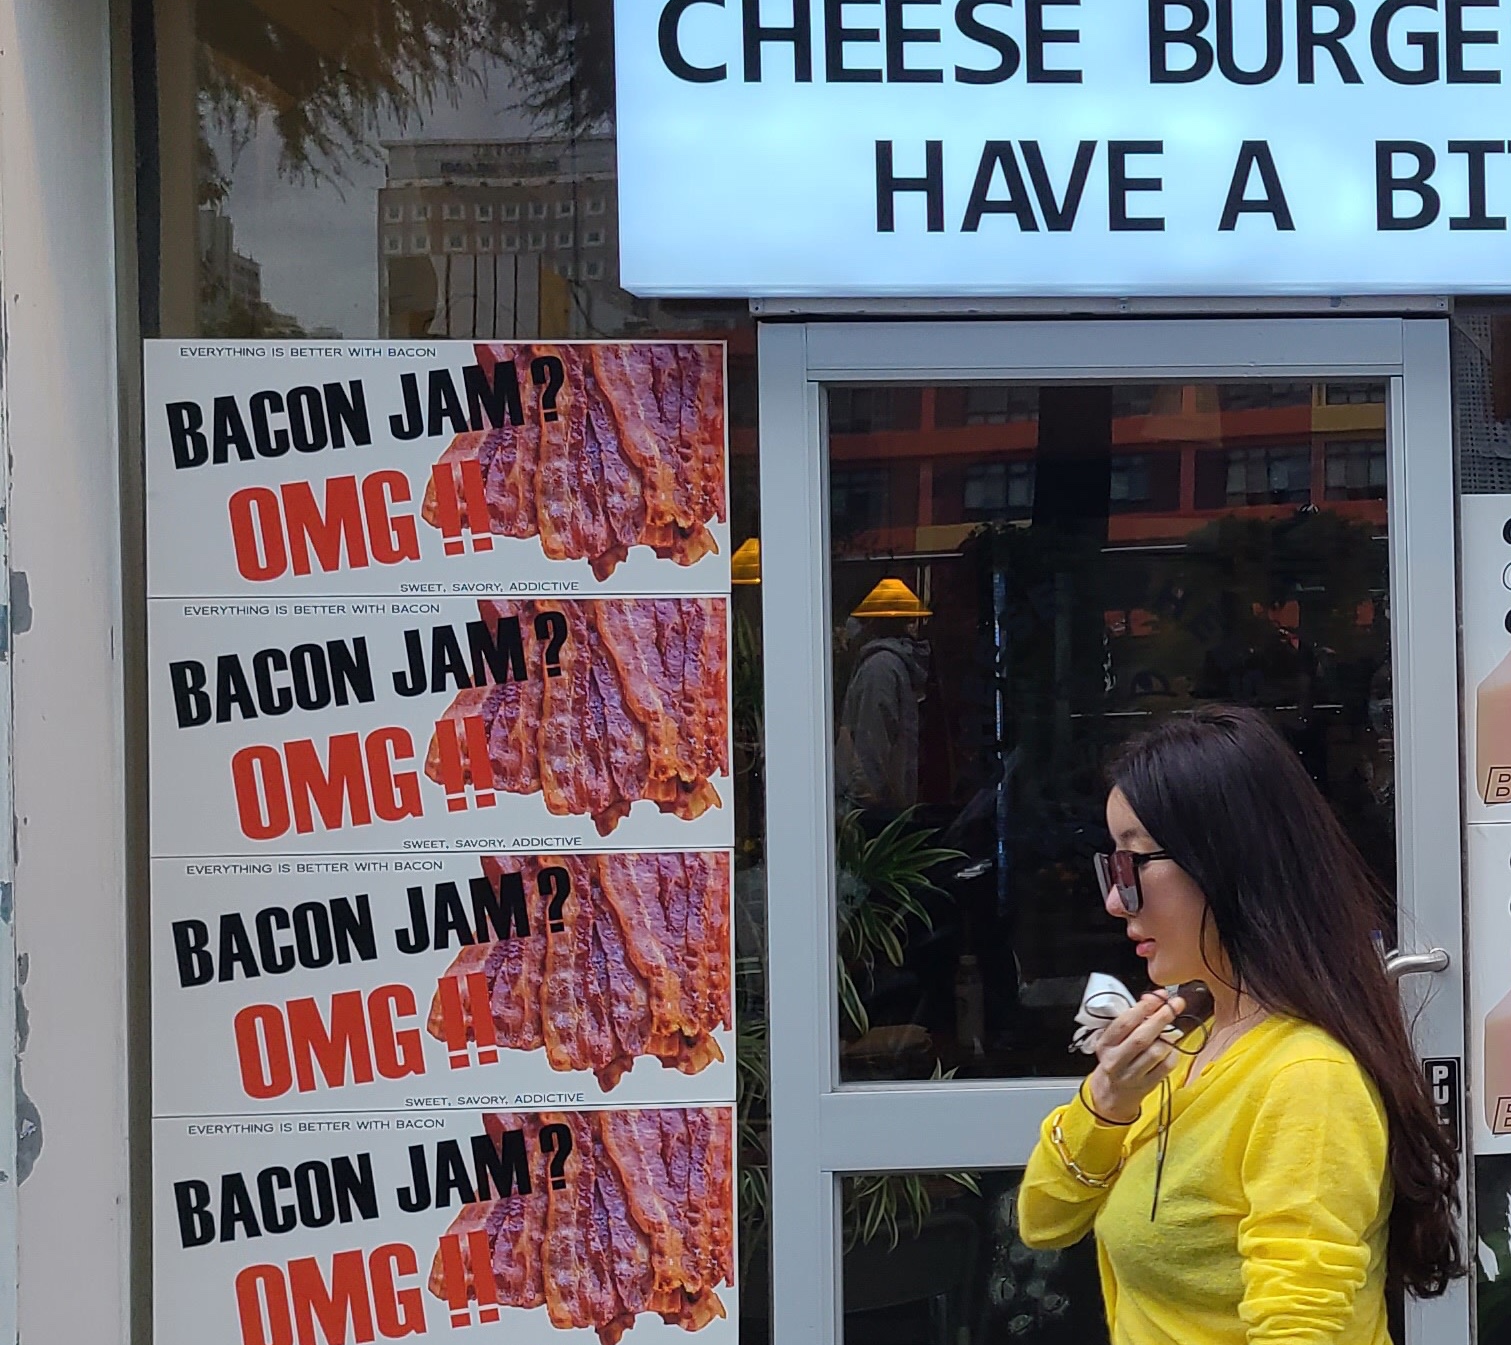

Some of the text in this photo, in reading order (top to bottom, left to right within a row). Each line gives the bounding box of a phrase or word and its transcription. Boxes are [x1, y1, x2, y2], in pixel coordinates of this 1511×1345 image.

[875, 139, 1166, 233] HAVE
[1217, 139, 1297, 232] A
[180, 347, 436, 358] EVERYTHING IS BETTER WITH BACON
[166, 379, 371, 469] BACON
[400, 582, 580, 593] SWEET, SAVORY, ADDICTIVE
[184, 603, 440, 616] EVERYTHING IS BETTER WITH BACON
[170, 636, 375, 729] BACON
[402, 836, 582, 850] SWEET, SAVORY, ADDICTIVE
[186, 860, 443, 875] EVERYTHING IS BETTER WITH BACON
[172, 894, 377, 988] BACON
[404, 1093, 585, 1108] SWEET, SAVORY, ADDICTIVE
[1432, 1065, 1451, 1125] PUL
[188, 1118, 445, 1135] EVERYTHING IS BETTER WITH BACON
[173, 1153, 379, 1248] BACON
